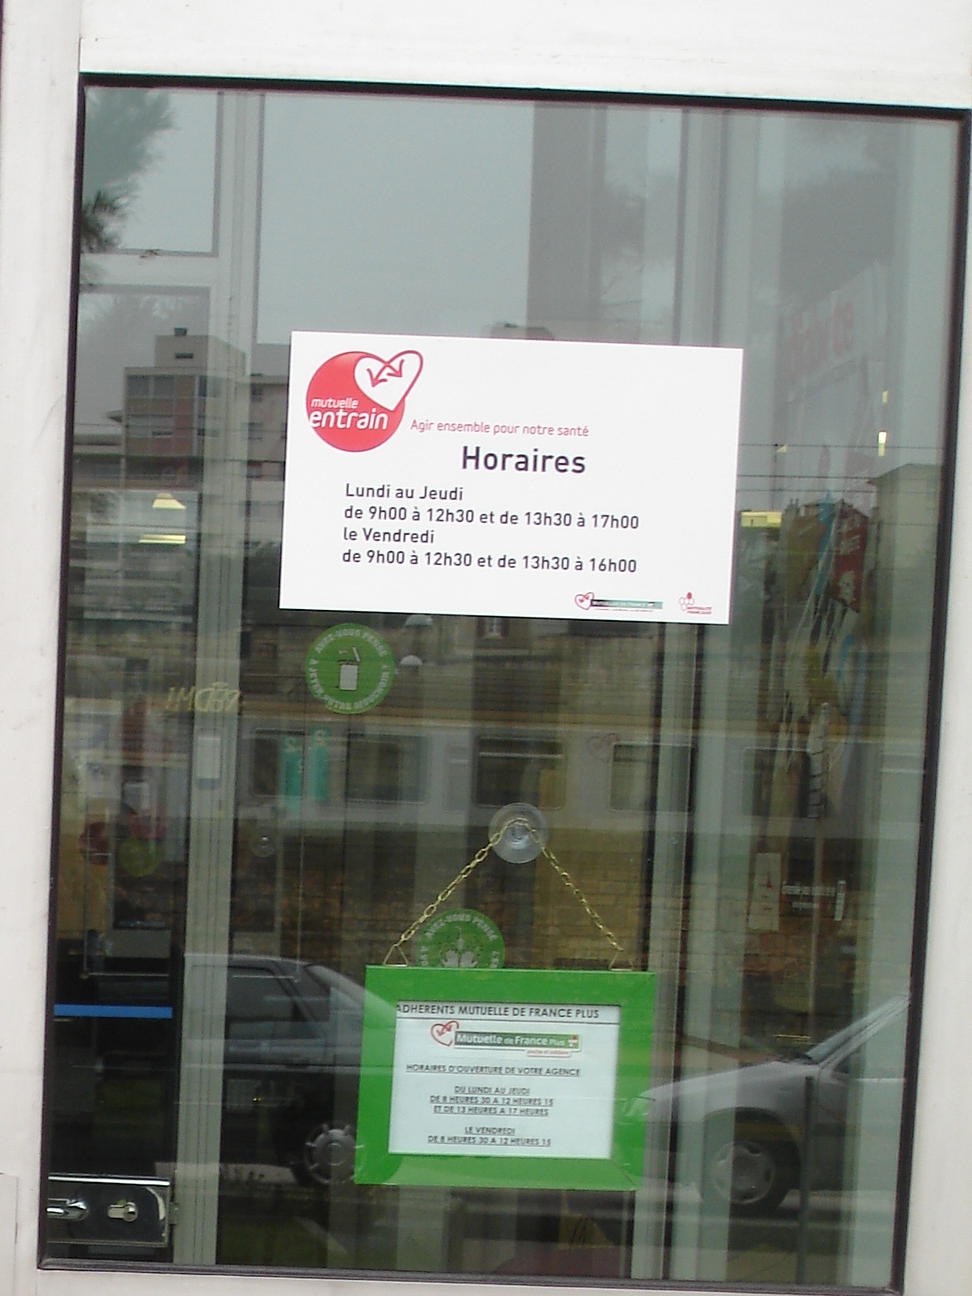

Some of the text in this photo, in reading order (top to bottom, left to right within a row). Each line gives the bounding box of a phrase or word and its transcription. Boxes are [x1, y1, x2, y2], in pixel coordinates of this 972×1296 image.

[311, 397, 358, 409] mutuelle
[309, 408, 388, 430] entrain
[410, 419, 589, 437] Agir ensemble pour notre santé
[461, 445, 586, 474] Horaires
[345, 483, 463, 501] Lundi au Jeudi
[344, 505, 639, 529] de 9h00 à 12h30 et de 13h30 à 17h00
[343, 527, 435, 543] le Vendredi
[342, 549, 637, 573] de 9h00 à 12h30 et de 13h30 à 16h00
[396, 1004, 599, 1019] ADHERENTS MUTUELLE DE FRANCE PLUS
[456, 1033, 503, 1045] Mutuelle
[515, 1036, 549, 1046] France
[406, 1064, 446, 1073] HORAIRES
[504, 1067, 515, 1075] DE
[517, 1067, 543, 1076] VOTRE
[545, 1068, 580, 1077] AGENCE
